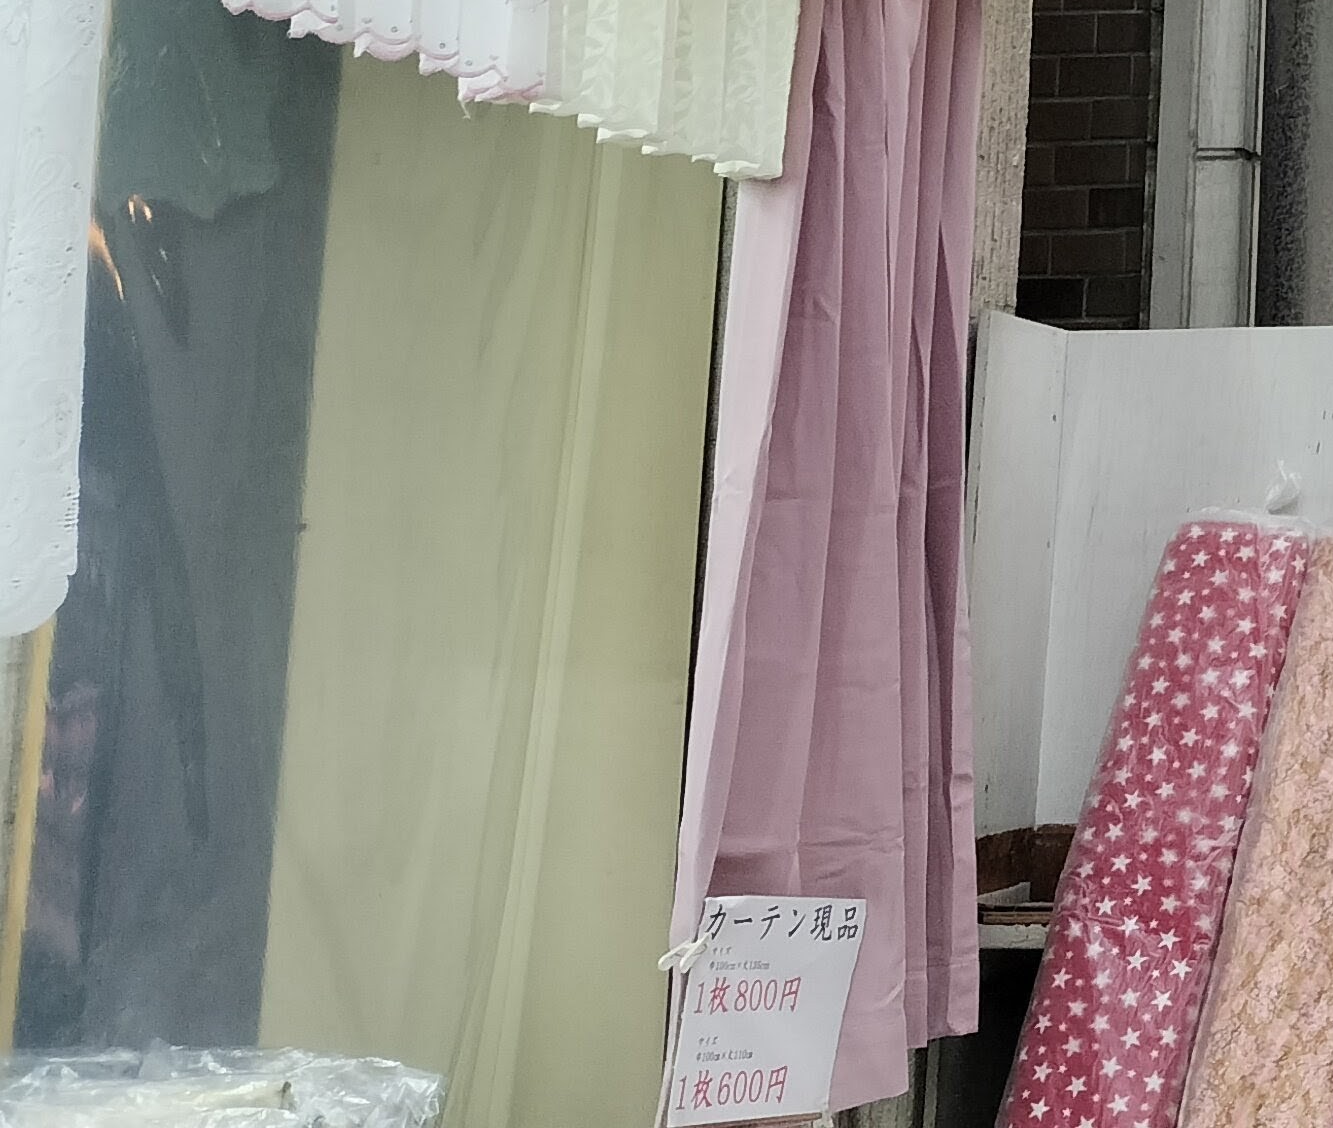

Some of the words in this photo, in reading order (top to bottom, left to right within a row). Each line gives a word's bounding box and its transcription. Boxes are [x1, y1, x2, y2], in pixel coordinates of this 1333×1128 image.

[704, 902, 860, 942] カーテン現品
[693, 975, 802, 1015] 1枚800円
[675, 1064, 789, 1112] 1枚600円
